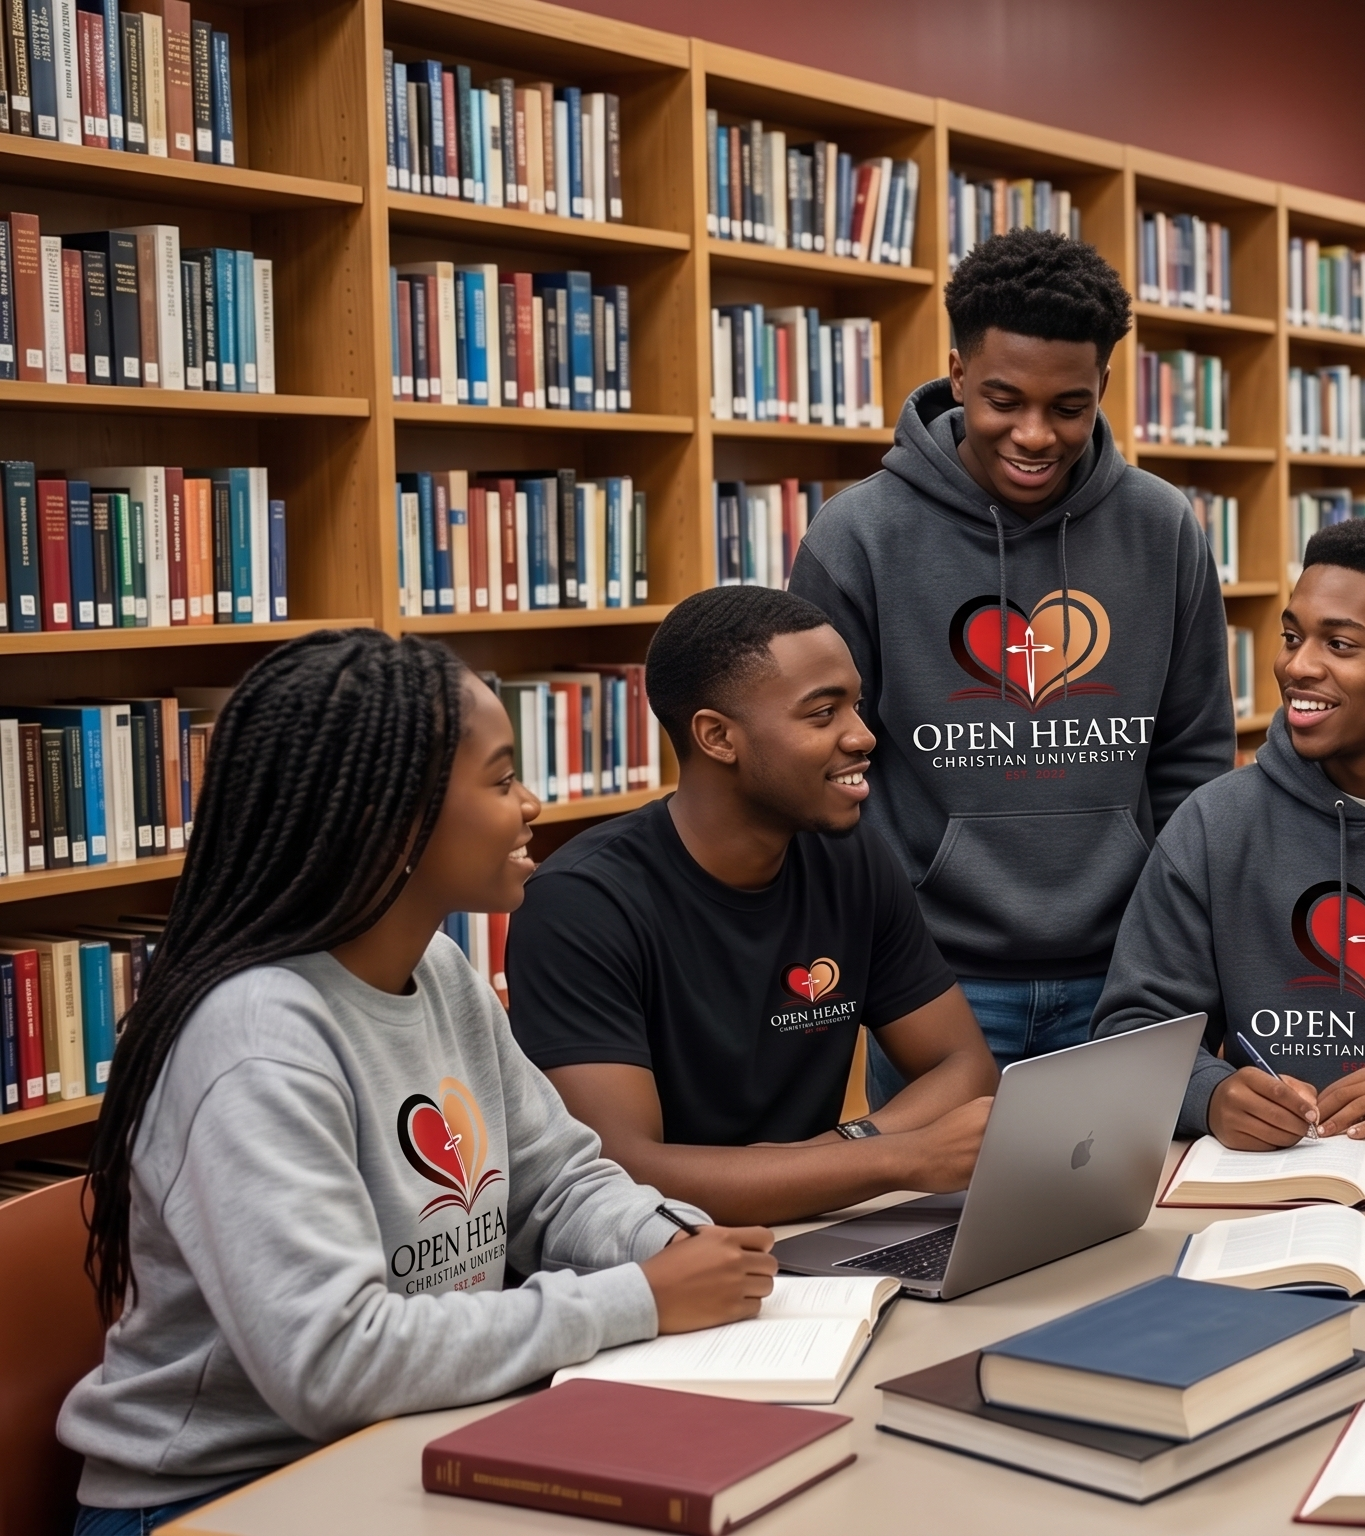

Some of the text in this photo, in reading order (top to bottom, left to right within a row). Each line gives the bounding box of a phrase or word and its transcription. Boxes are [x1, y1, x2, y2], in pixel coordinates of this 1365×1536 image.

[912, 716, 1155, 752] OPEN HEART
[932, 749, 1137, 769] CHRISTIAN UNIVERSITY
[770, 1001, 857, 1027] OPEN HEART
[1250, 1009, 1356, 1038] OPEN
[1269, 1043, 1364, 1057] CHRISTIAN
[391, 1206, 508, 1278] OPEN HEA
[405, 1243, 506, 1295] CHRISTIAN UNIVER
